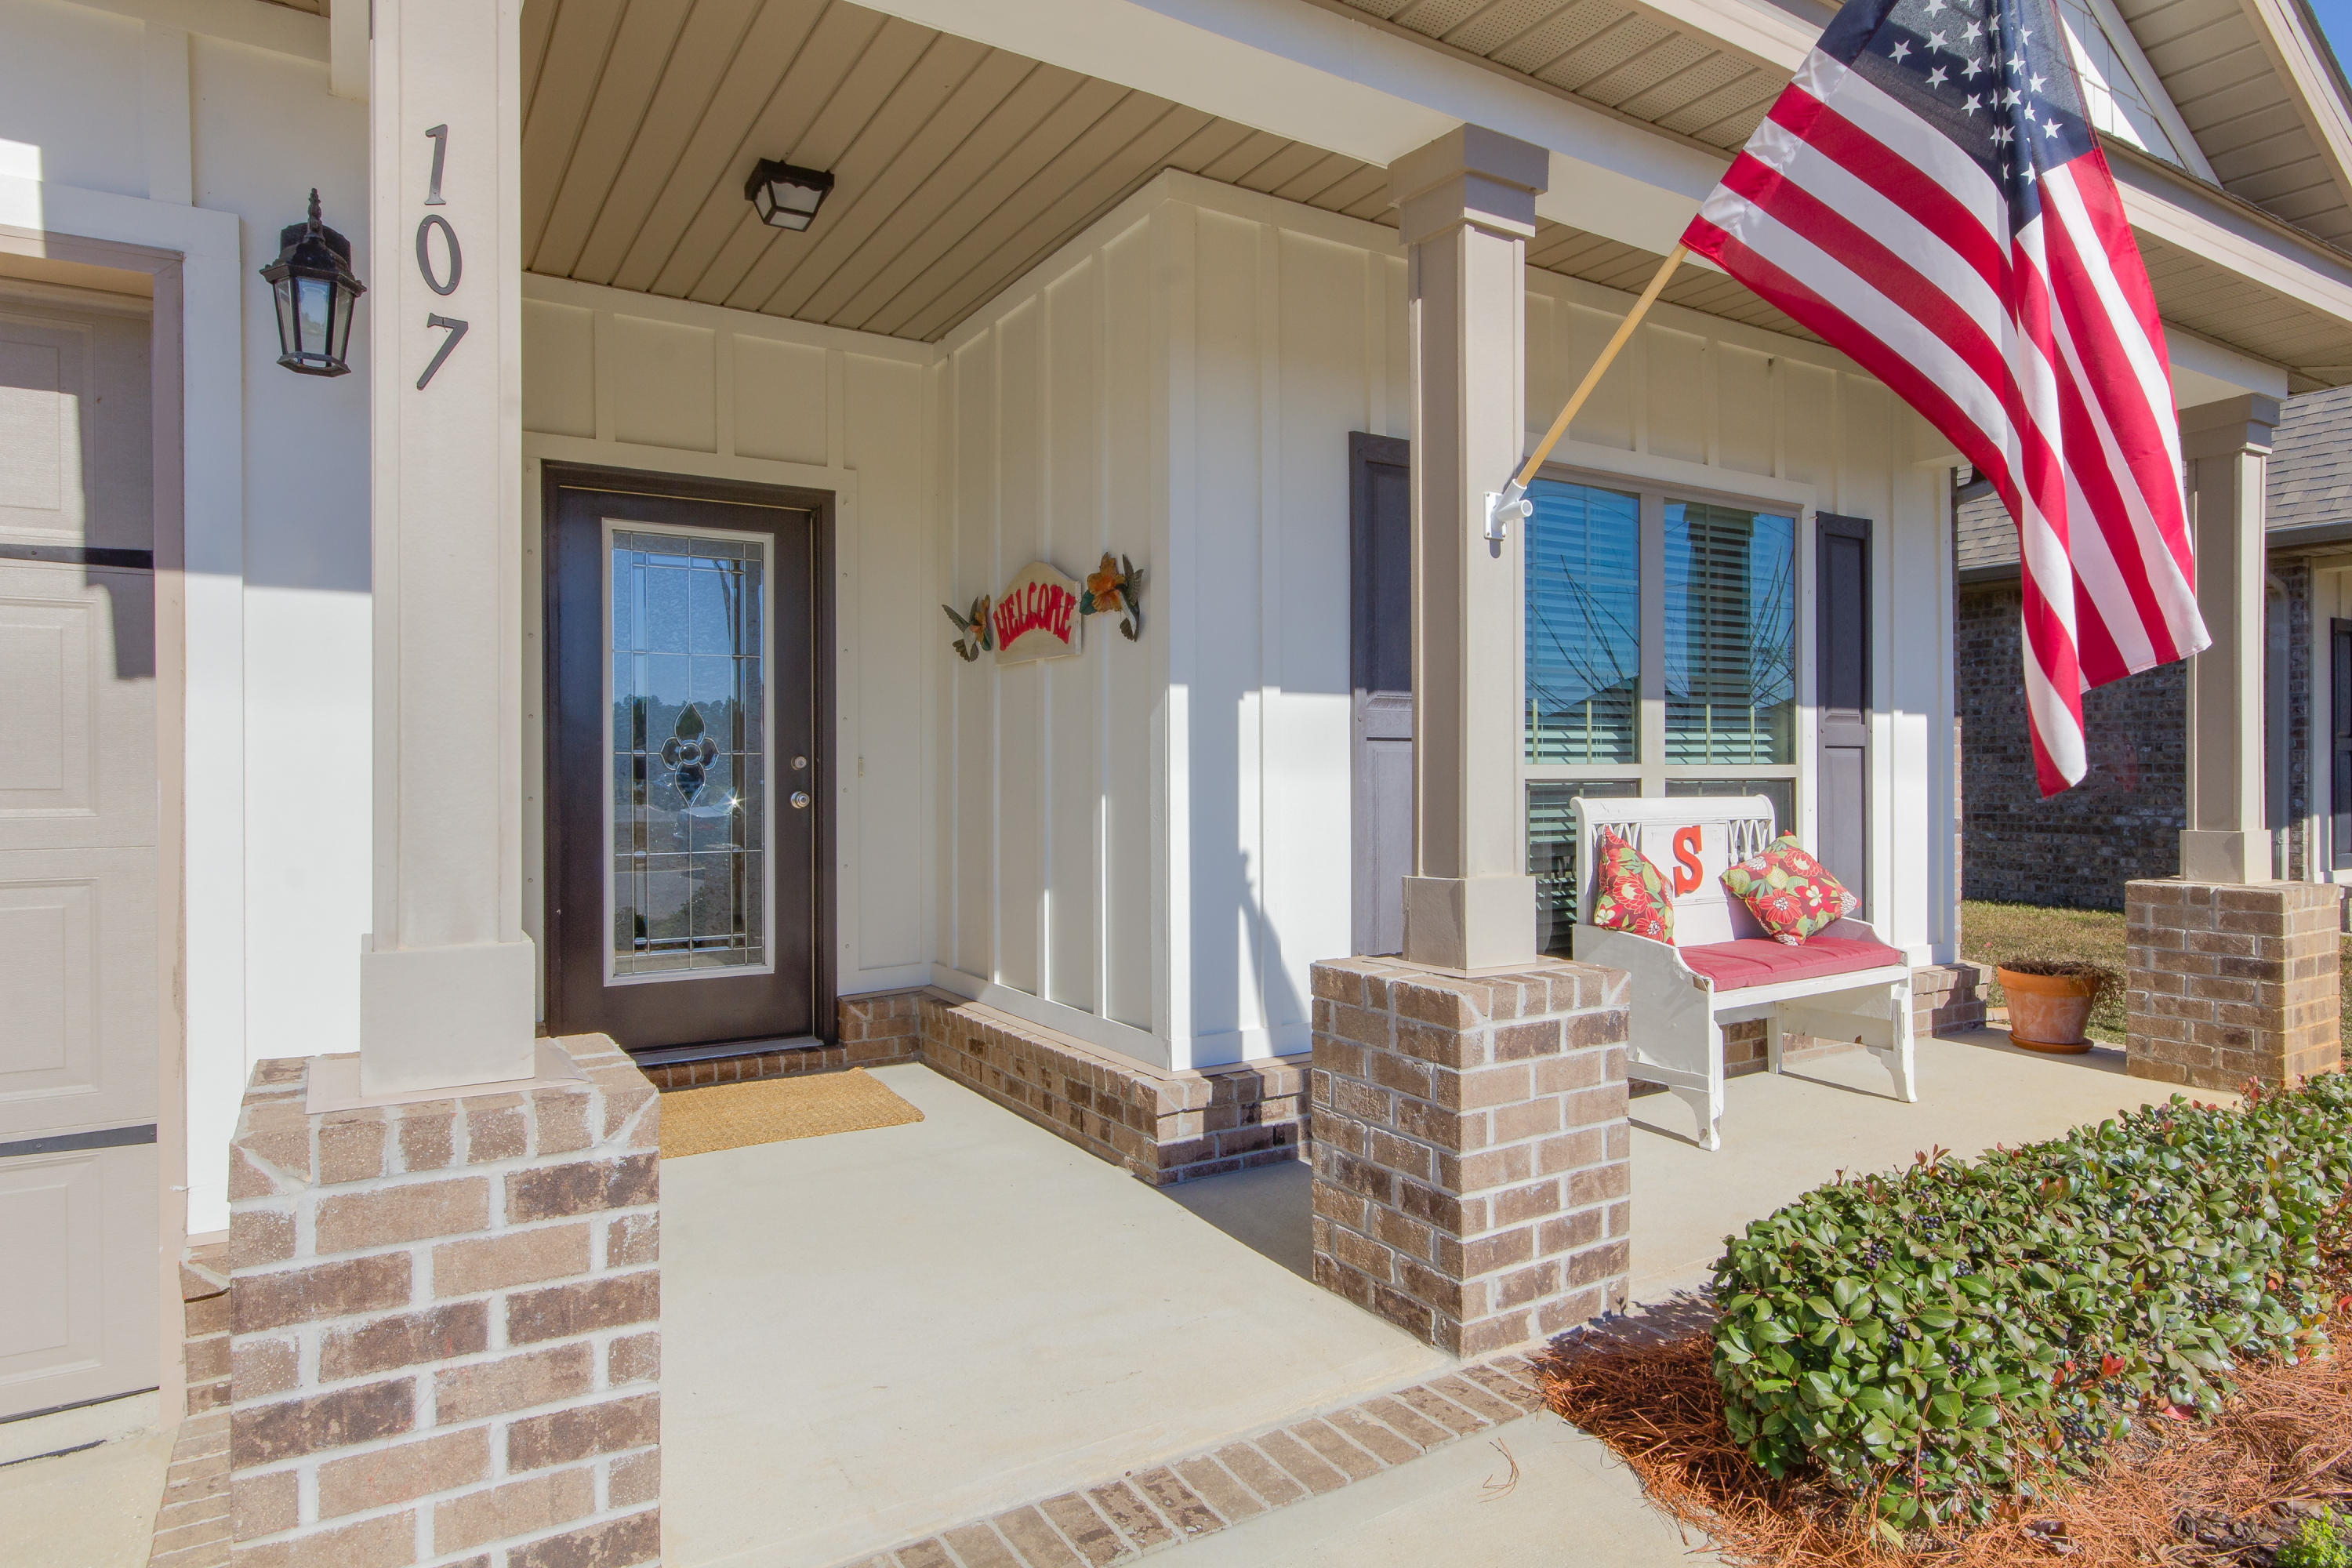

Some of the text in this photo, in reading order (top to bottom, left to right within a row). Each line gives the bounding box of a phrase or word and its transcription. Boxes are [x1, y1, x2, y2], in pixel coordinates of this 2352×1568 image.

[416, 123, 469, 390] 107
[993, 583, 1076, 651] WELCOME
[1673, 825, 1703, 897] S
